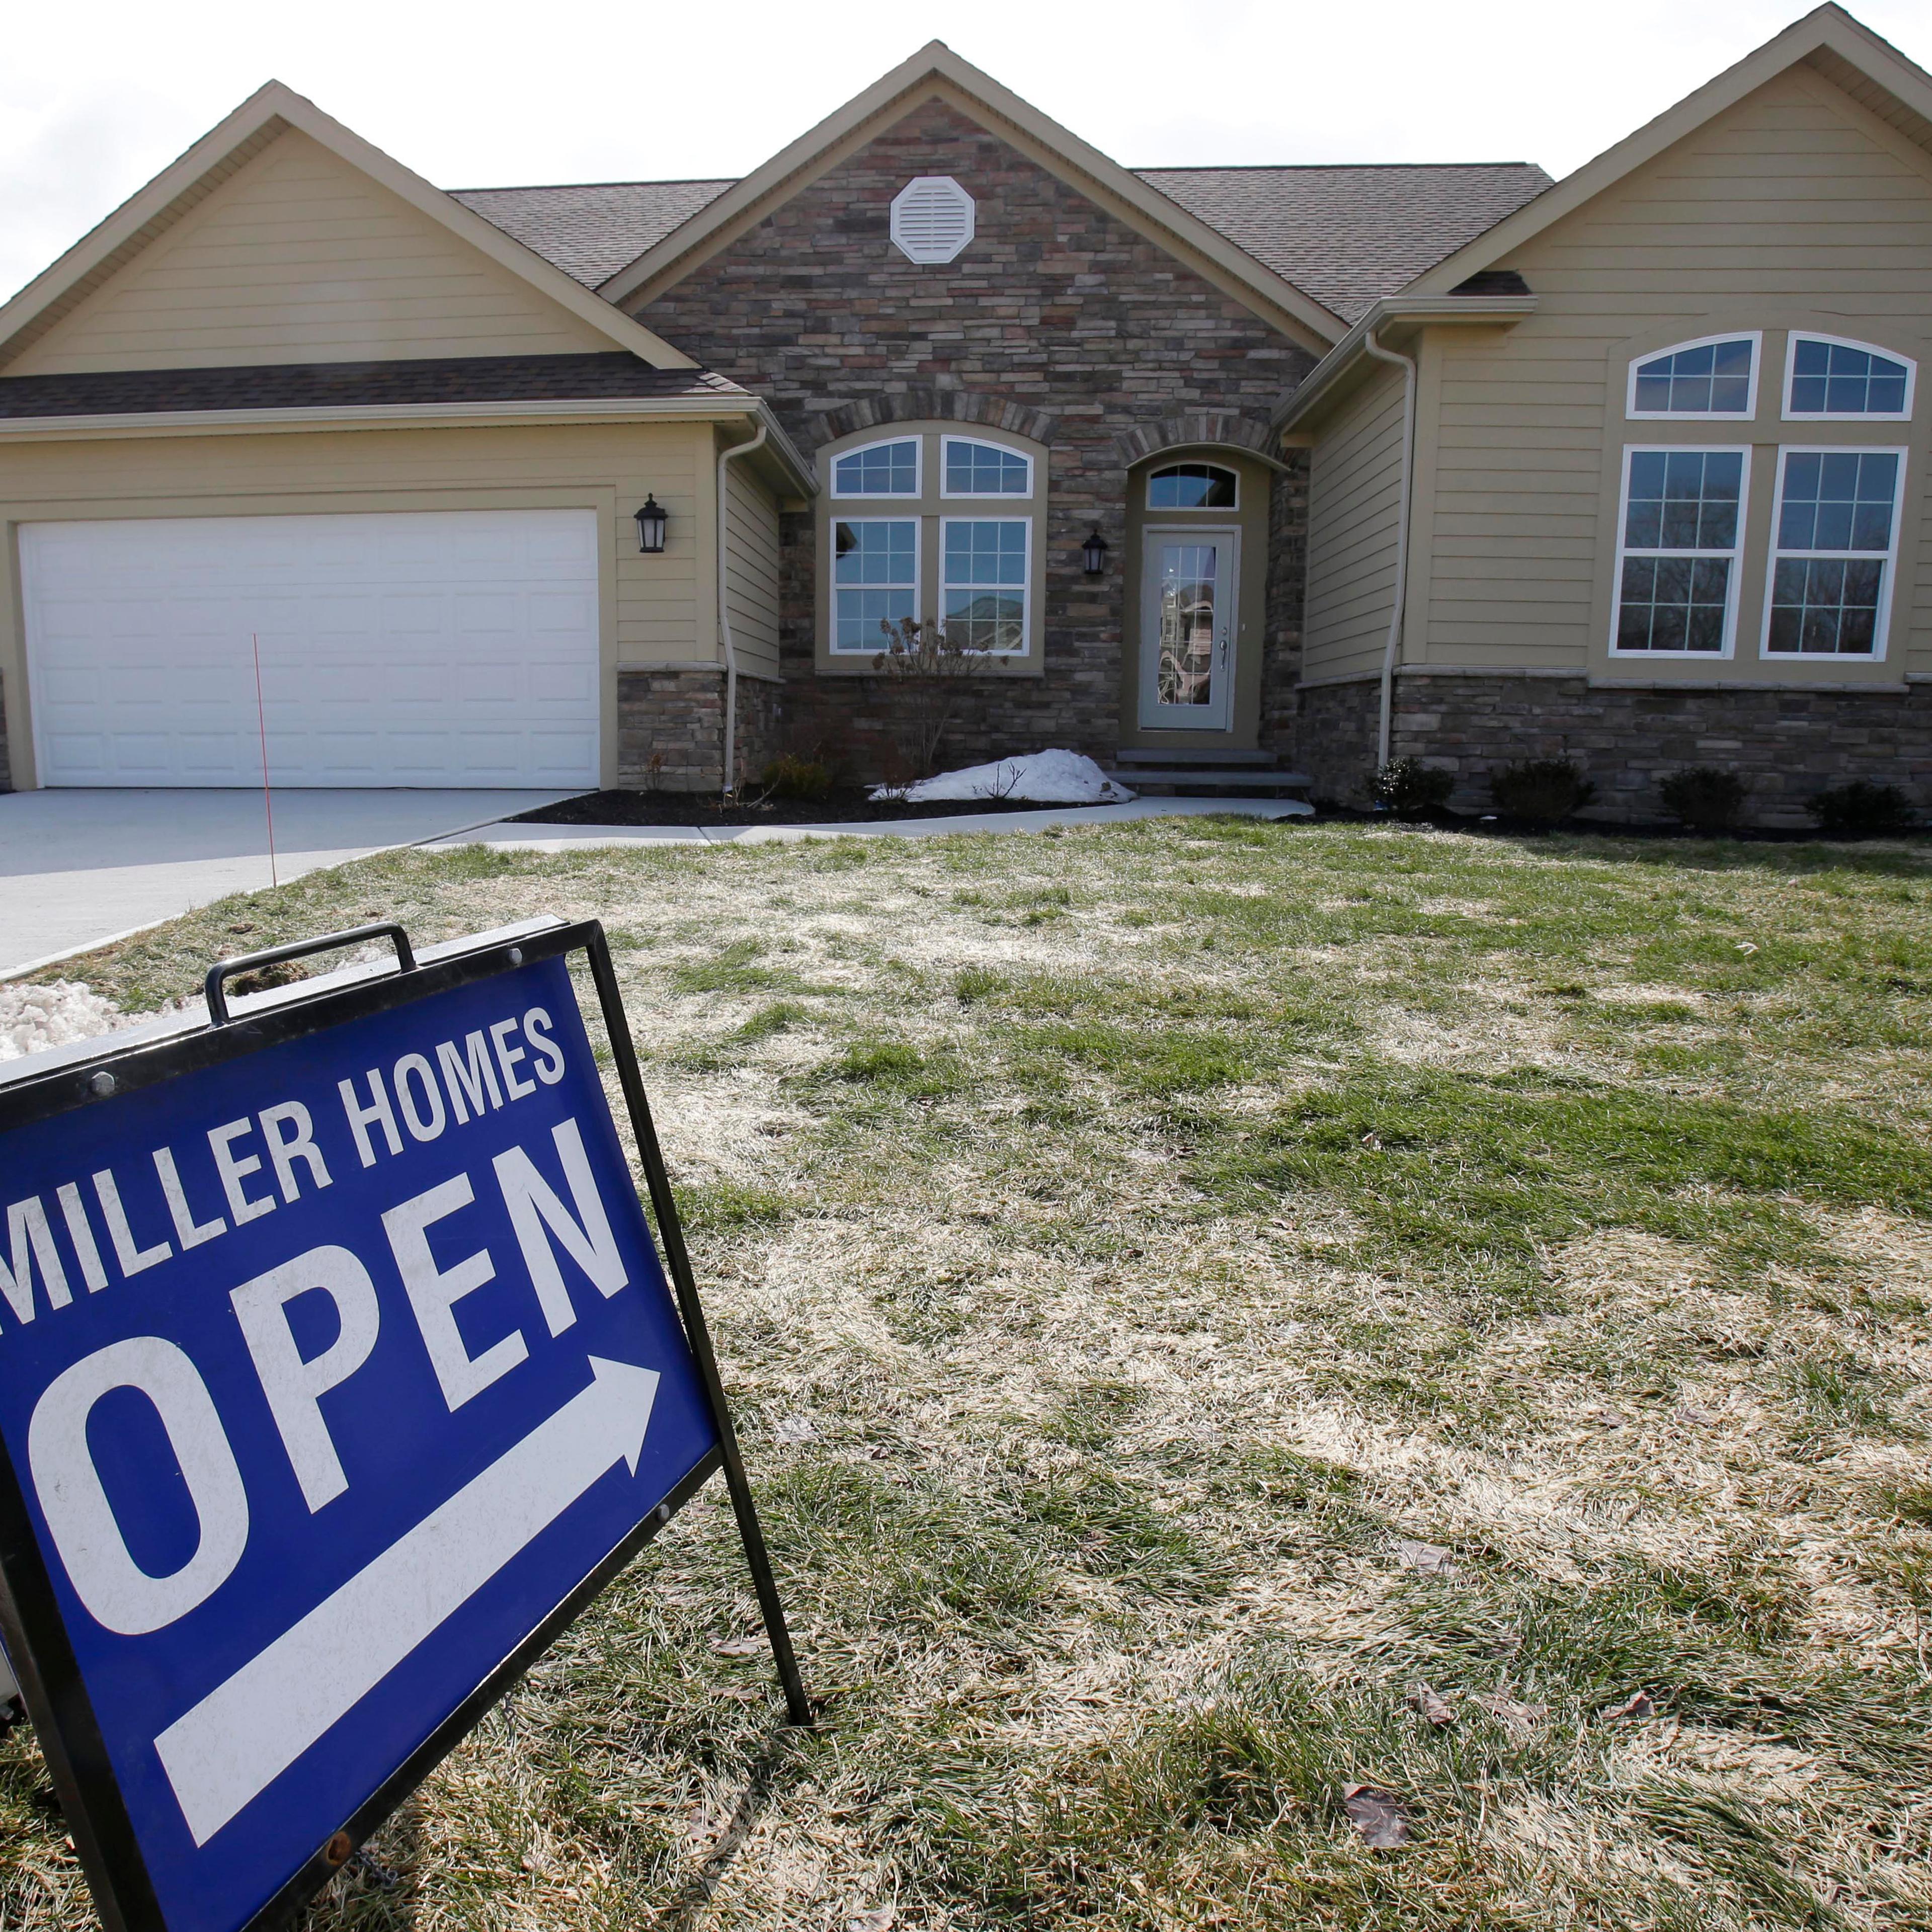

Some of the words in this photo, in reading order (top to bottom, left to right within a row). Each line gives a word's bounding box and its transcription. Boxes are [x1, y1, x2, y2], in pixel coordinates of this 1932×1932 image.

[0, 1101, 334, 1335] MILLER
[337, 1007, 565, 1168] HOMES
[28, 1117, 629, 1635] OPEN
